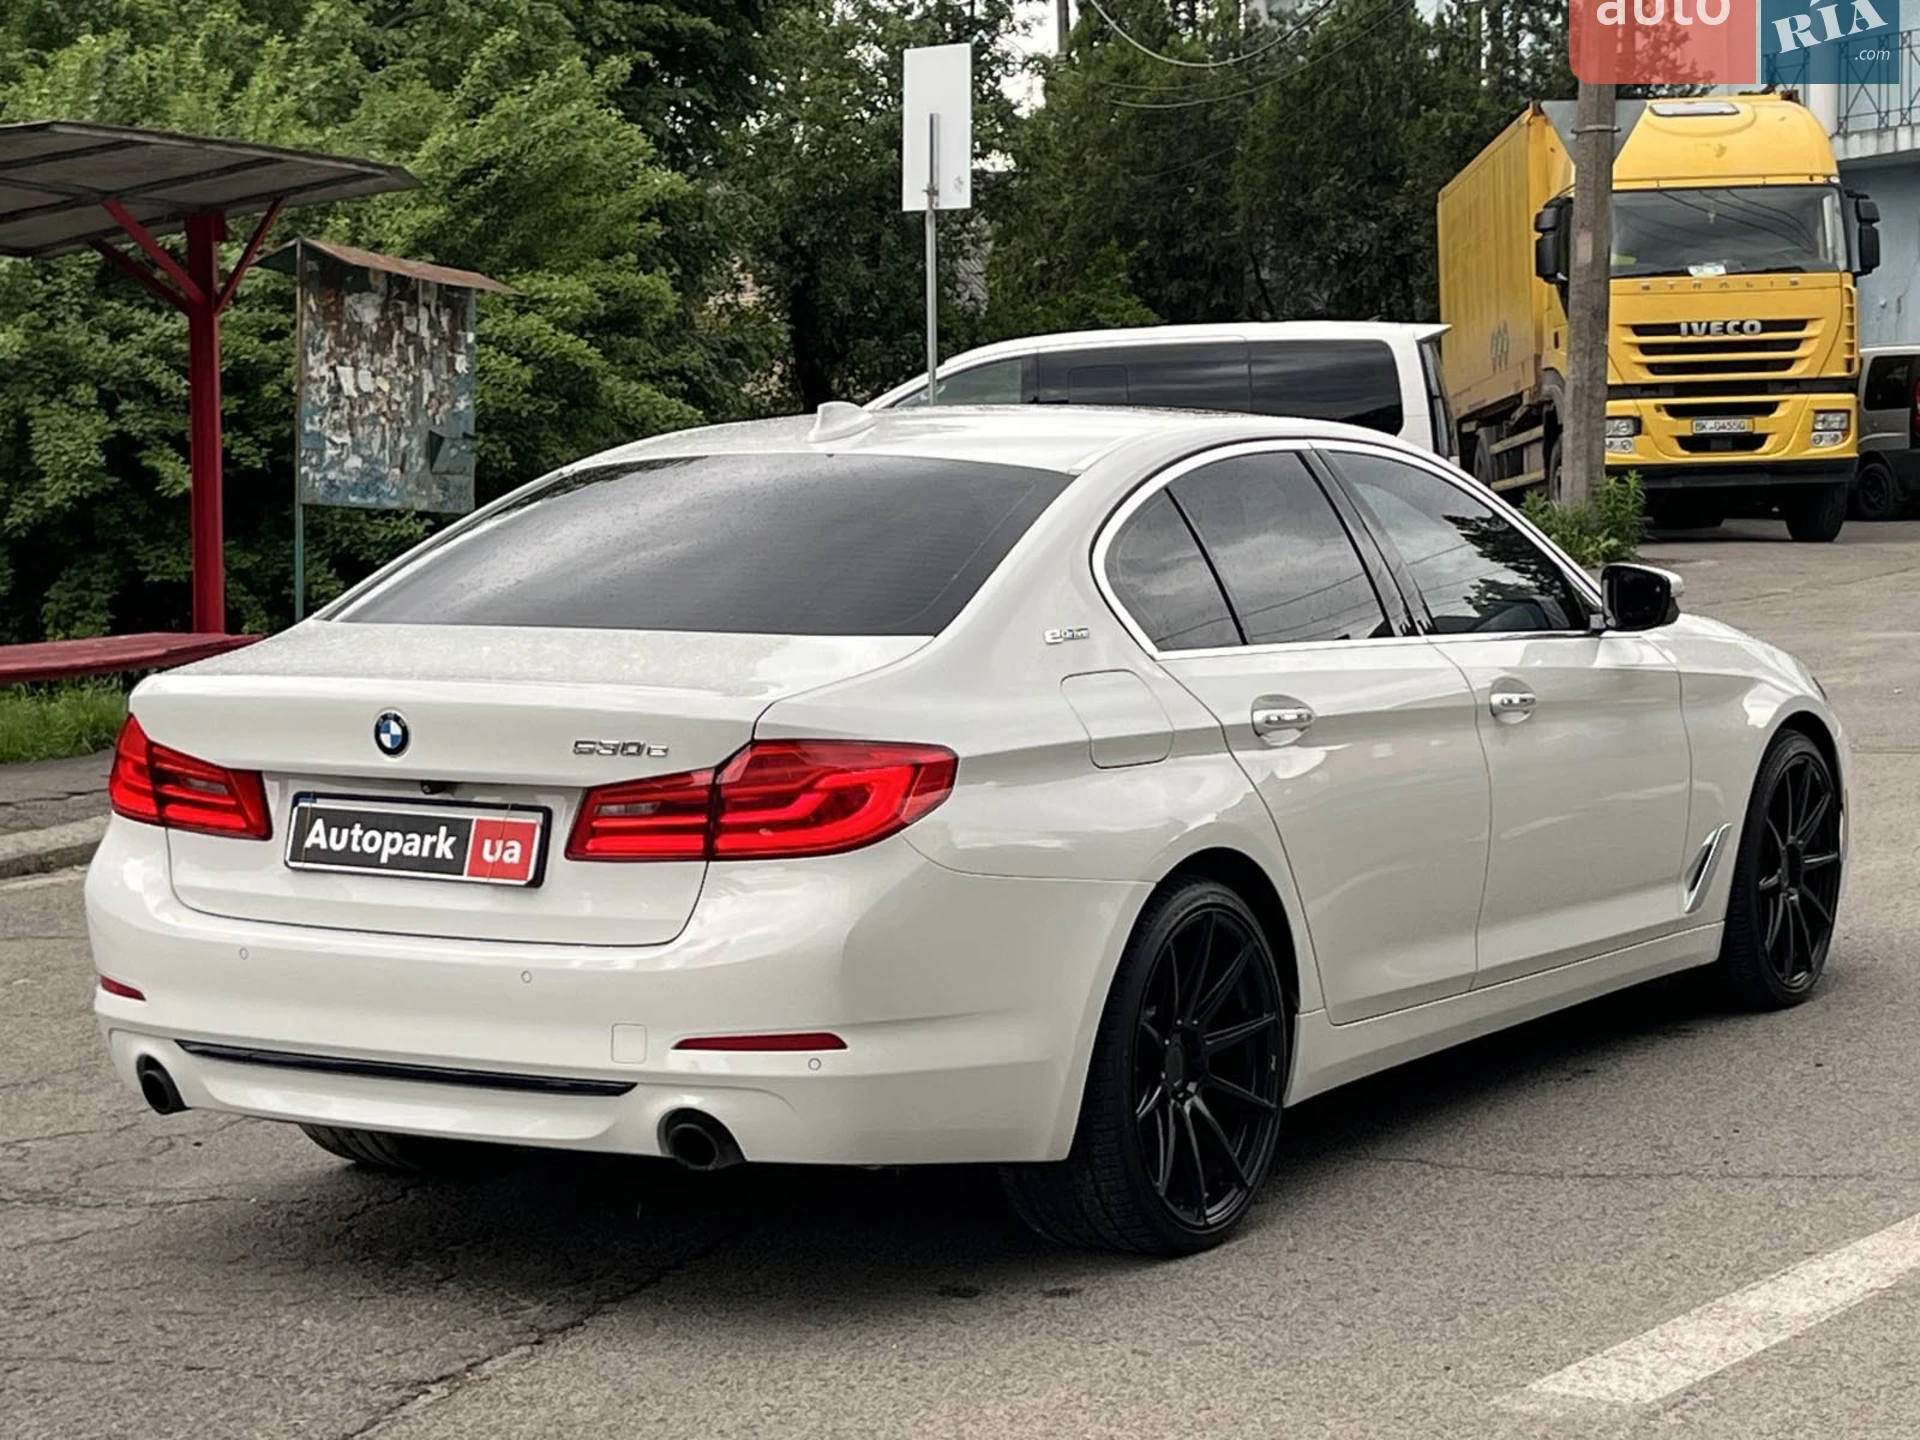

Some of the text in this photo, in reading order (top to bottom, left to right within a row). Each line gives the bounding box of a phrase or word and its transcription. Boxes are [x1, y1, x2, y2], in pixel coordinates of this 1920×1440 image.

[1679, 319, 1763, 337] IVECO
[304, 817, 522, 865] Autopark ua
